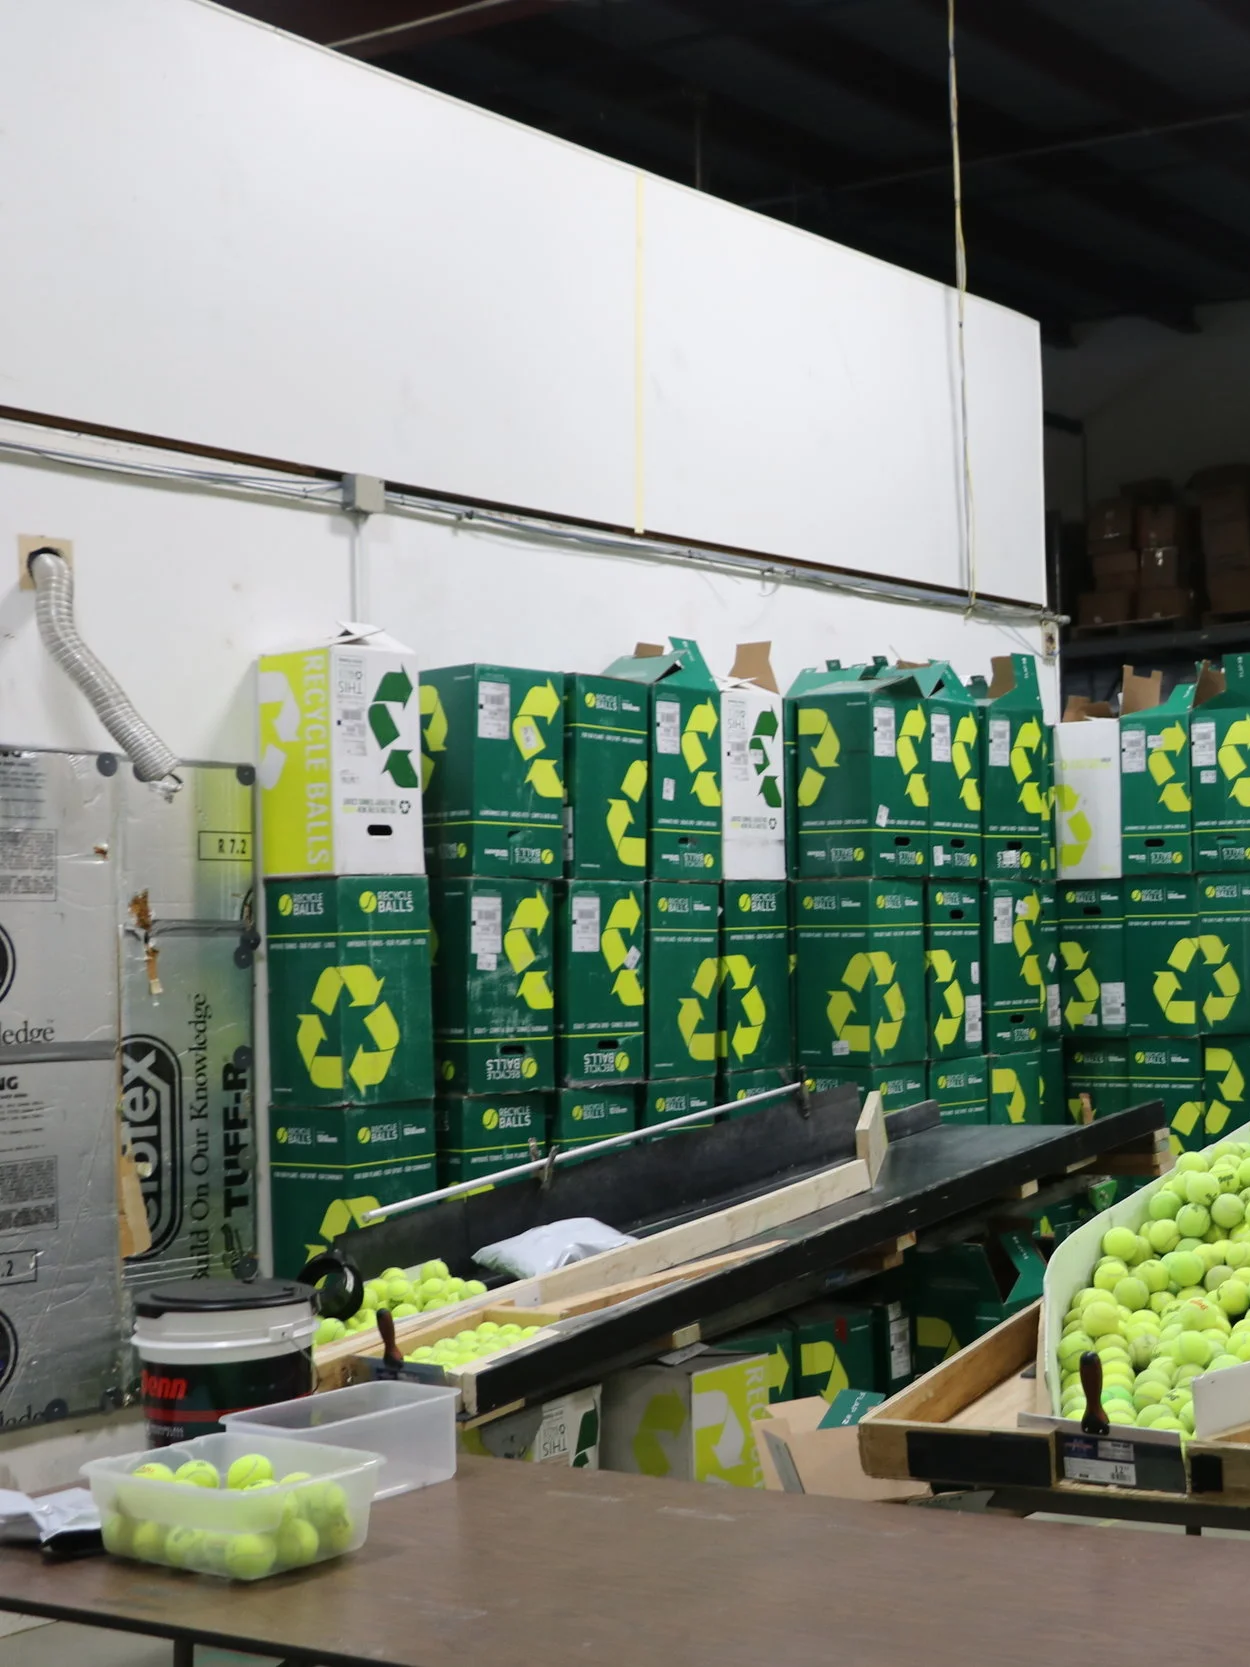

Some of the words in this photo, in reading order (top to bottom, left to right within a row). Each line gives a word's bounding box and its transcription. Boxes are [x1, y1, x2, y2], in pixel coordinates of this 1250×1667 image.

[303, 655, 329, 773] RECYCLE
[304, 780, 331, 866] BALLS
[218, 838, 226, 854] R
[229, 838, 248, 854] 7.2
[293, 893, 324, 902] RECYCLE
[377, 891, 412, 900] RECYCLE
[293, 902, 324, 915] BALLS
[378, 900, 414, 913] BALLS
[751, 901, 776, 912] BALLS
[187, 993, 212, 1121] Knowledge
[583, 1053, 614, 1064] BALLS
[485, 1058, 521, 1070] BALLS
[584, 1064, 615, 1074] RECYCLE
[486, 1070, 521, 1080] RECYCLE
[498, 1105, 531, 1116] RECYCLE
[498, 1114, 532, 1129] BALLS
[223, 1062, 249, 1218] TUFF-R
[371, 1130, 398, 1143] BALLS
[191, 1128, 210, 1175] Our
[191, 1183, 210, 1221] On
[543, 1438, 568, 1457] THIS
